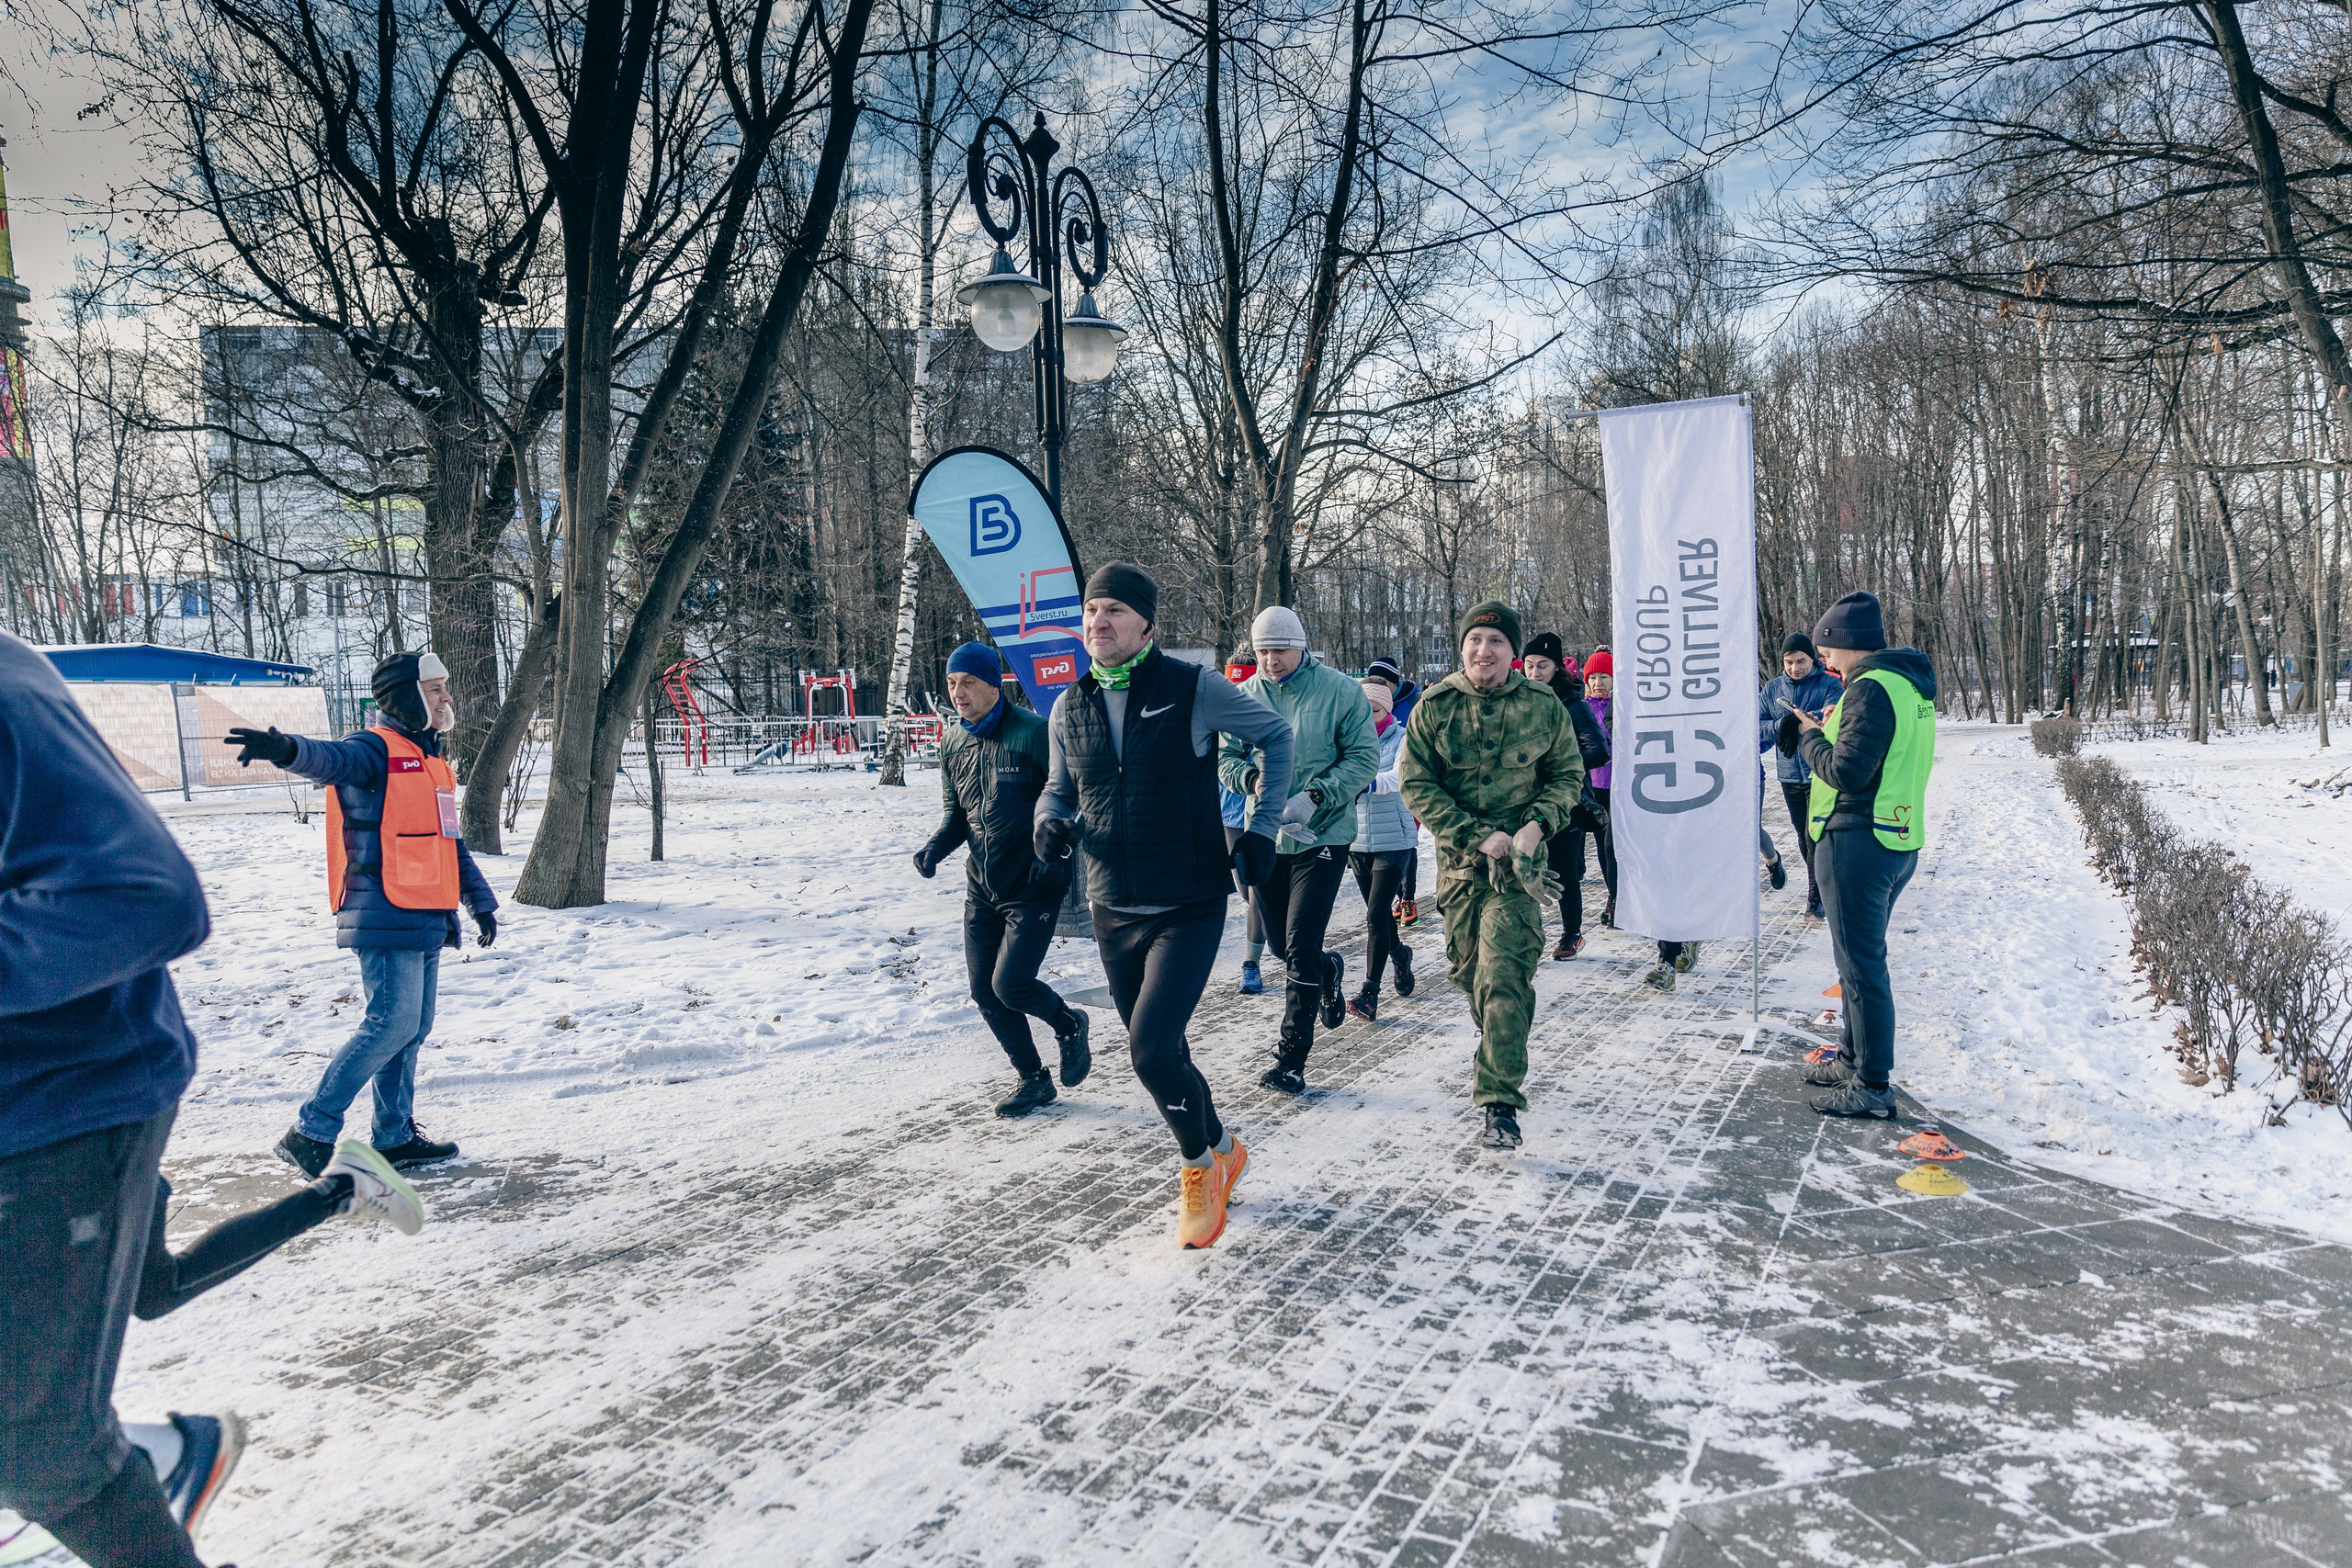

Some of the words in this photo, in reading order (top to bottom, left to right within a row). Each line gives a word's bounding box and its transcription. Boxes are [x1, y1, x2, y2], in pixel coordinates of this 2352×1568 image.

[1030, 610, 1068, 622] 5verst.ru
[209, 758, 236, 768] ВДНХ
[211, 769, 238, 779] ВДНХ
[240, 768, 256, 777] ДЛЯ
[258, 766, 286, 775] КАЖД
